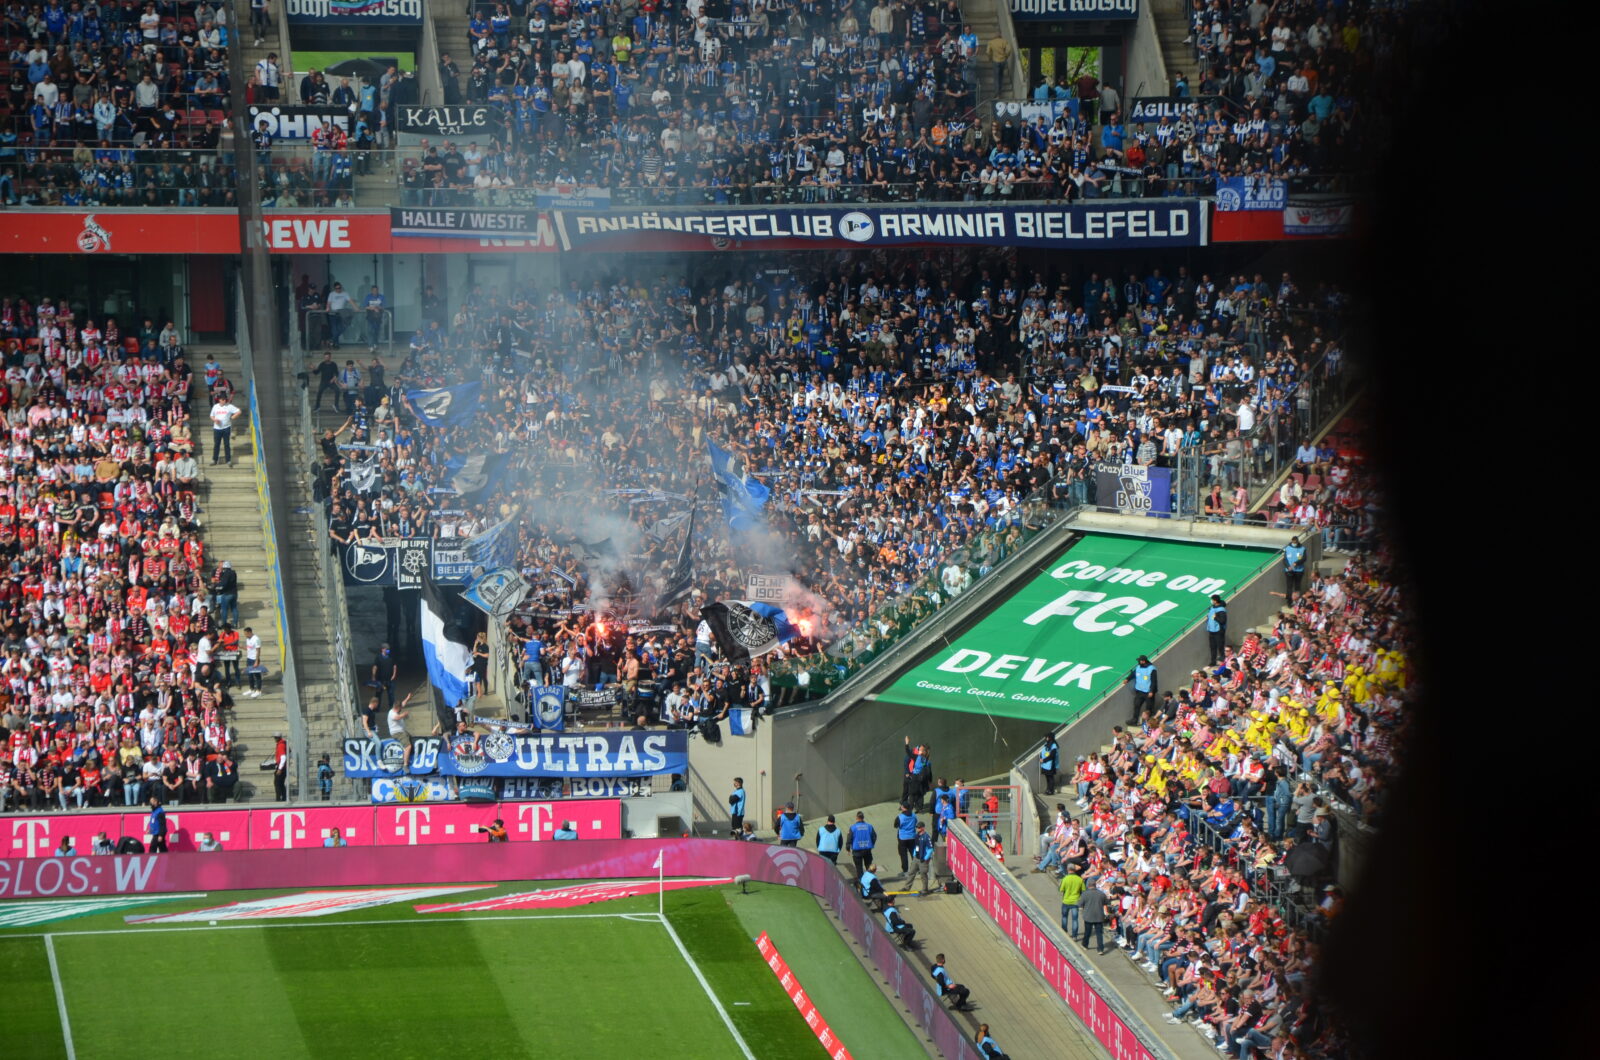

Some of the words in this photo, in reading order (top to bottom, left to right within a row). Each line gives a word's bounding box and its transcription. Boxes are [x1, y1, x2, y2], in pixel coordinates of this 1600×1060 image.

[406, 108, 487, 127] KALLE
[438, 126, 464, 135] TAL
[247, 219, 351, 249] REWE
[402, 211, 455, 227] HALLE
[470, 213, 527, 230] WESTF.
[576, 211, 833, 237] ANHÄNGERCLUB
[879, 212, 1005, 238] ARMINIA
[1014, 209, 1189, 239] BIELEFELD
[1098, 463, 1121, 476] Crazy
[1124, 465, 1145, 476] Blue
[437, 553, 458, 562] The
[1050, 559, 1168, 588] Come
[1165, 573, 1227, 596] on,
[1022, 589, 1179, 637] FC!
[936, 648, 1113, 690] DEVK
[916, 680, 962, 695] Gesagt.
[966, 686, 1006, 699] Getan.
[1011, 692, 1071, 708] Geholfen.
[515, 734, 667, 772] ULTRAS
[572, 777, 629, 797] BOYS
